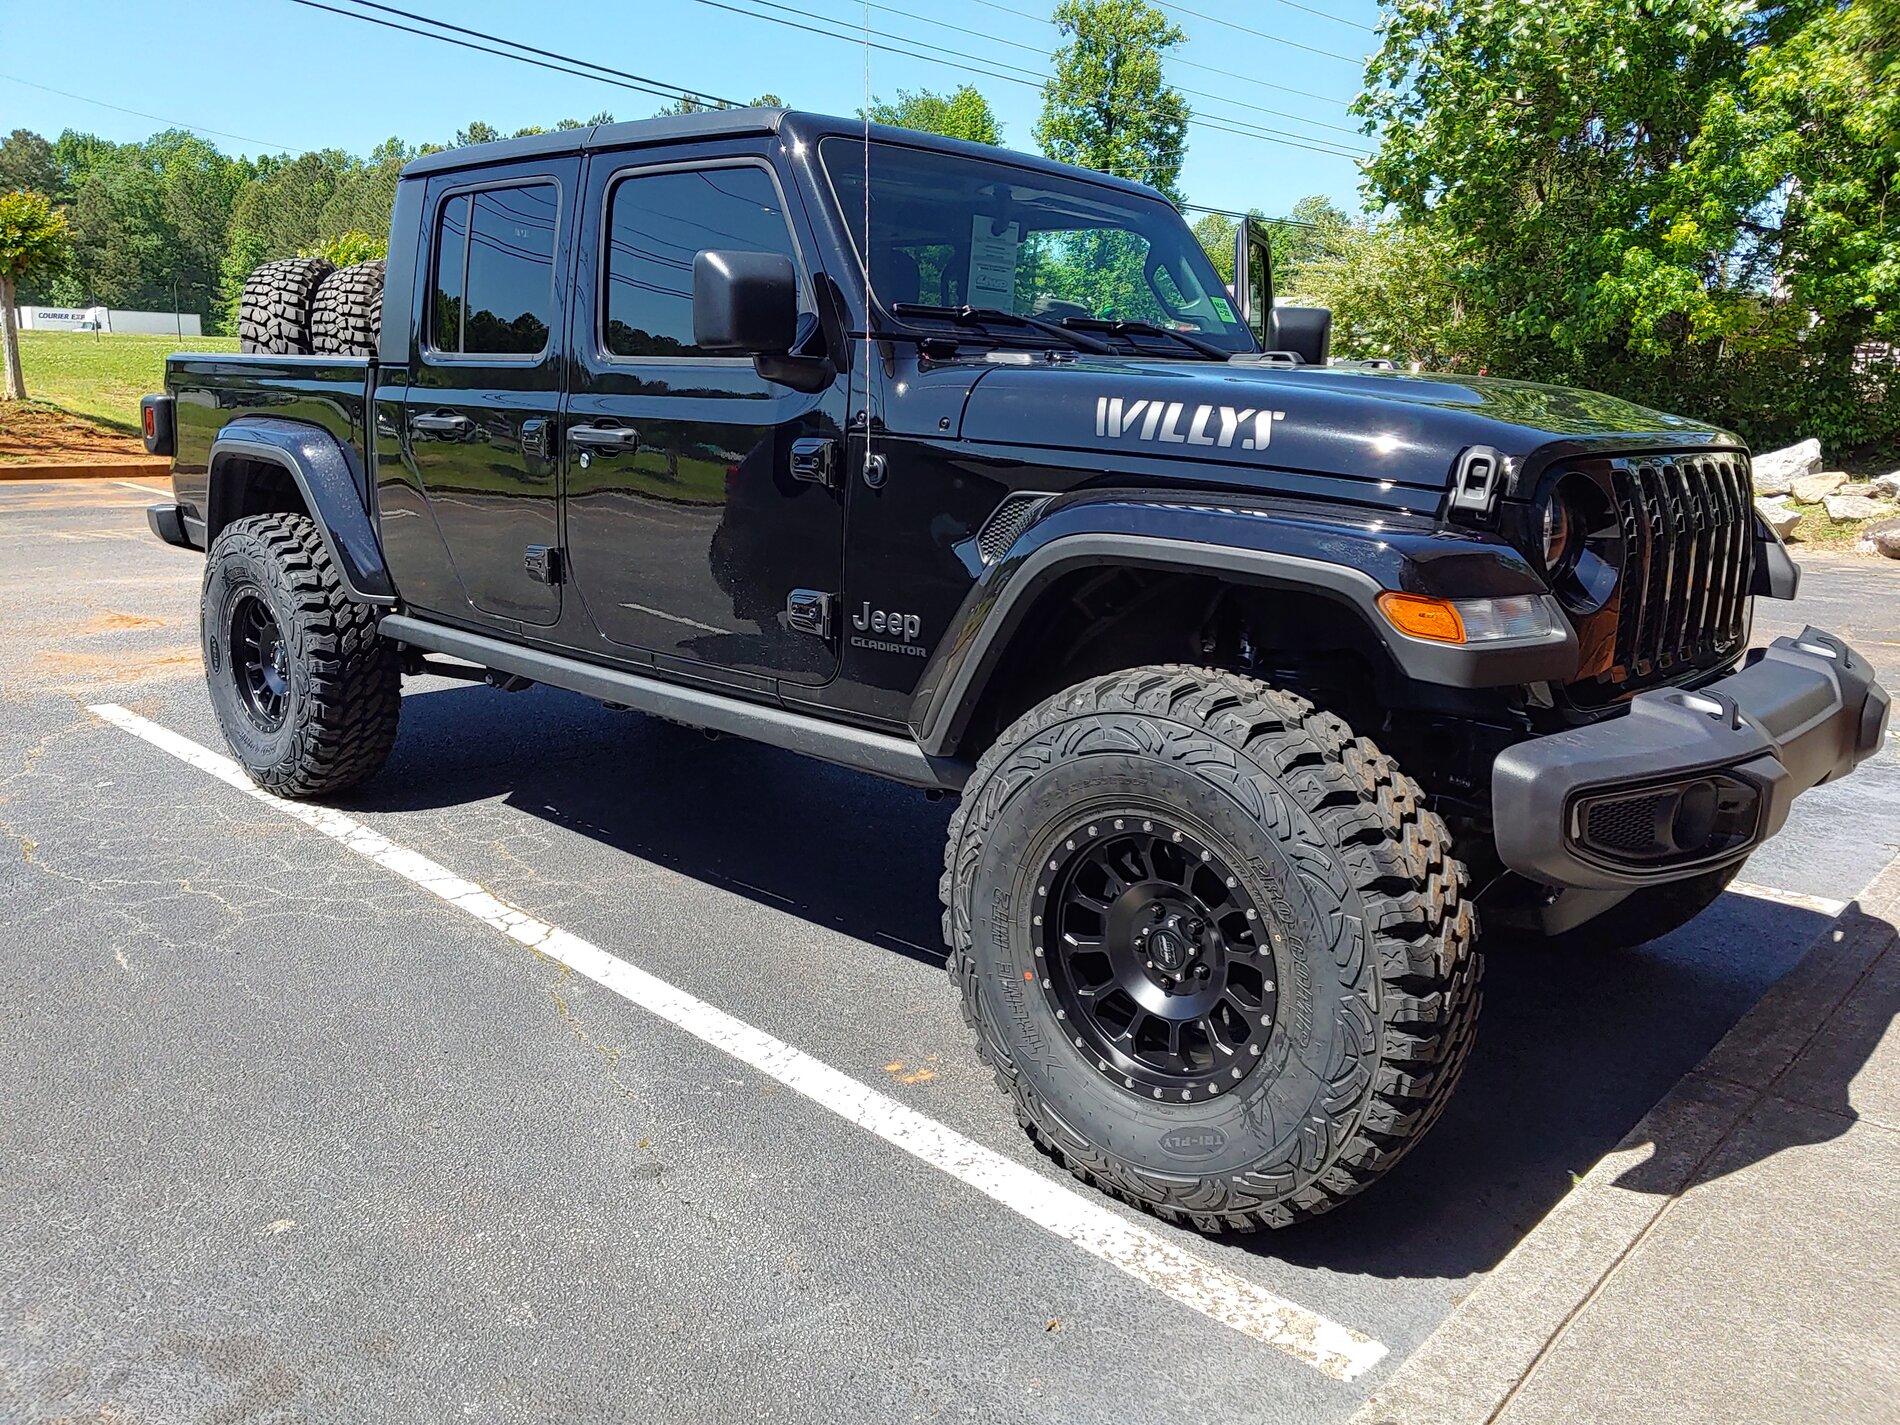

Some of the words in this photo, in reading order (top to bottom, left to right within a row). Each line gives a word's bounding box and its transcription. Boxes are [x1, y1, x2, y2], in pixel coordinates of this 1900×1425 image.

[38, 312, 69, 320] COURIER
[1096, 397, 1286, 450] WILLYS
[852, 601, 921, 643] Jeep
[850, 636, 928, 658] GLADIATOR
[1163, 1135, 1224, 1148] TRI-PLY
